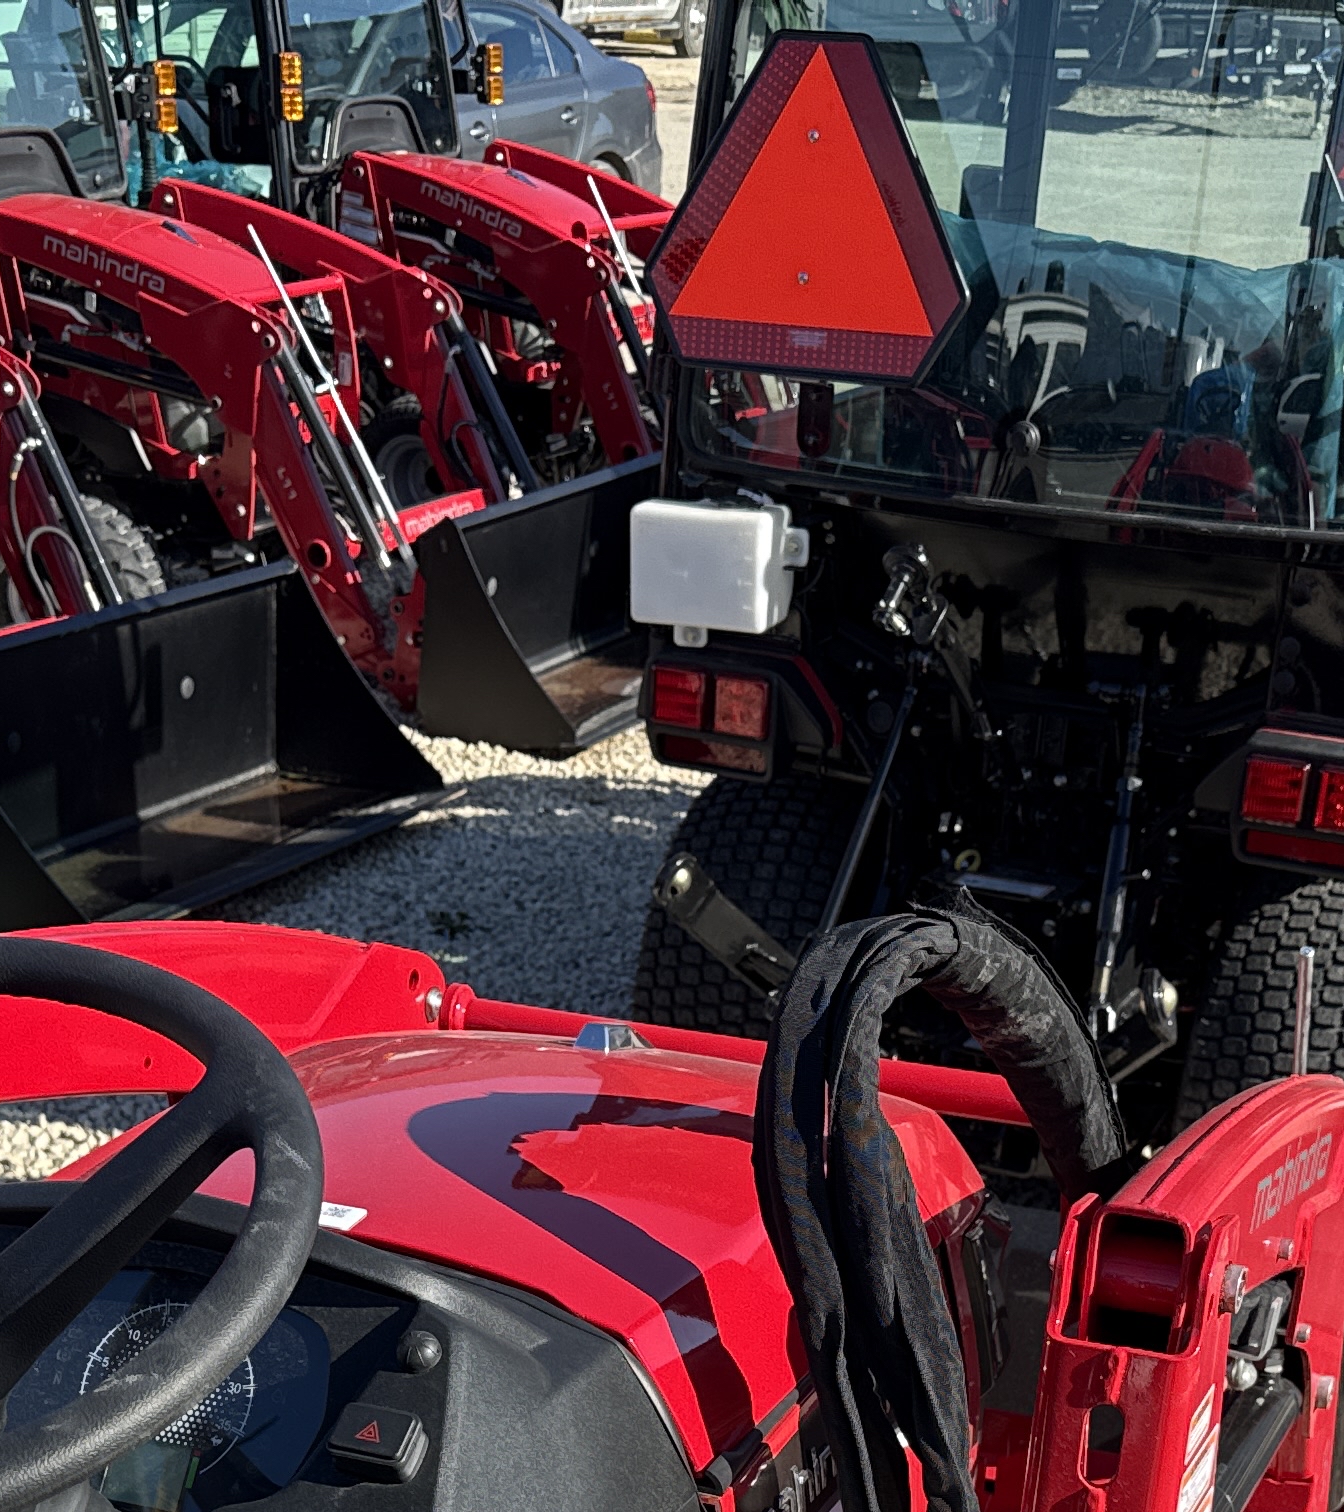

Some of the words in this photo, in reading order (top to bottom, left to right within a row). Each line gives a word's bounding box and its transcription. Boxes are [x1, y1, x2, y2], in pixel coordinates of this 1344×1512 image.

[420, 181, 523, 238] mahindra
[43, 234, 166, 295] mahindra
[1249, 1125, 1333, 1234] mahindra
[127, 1329, 142, 1342] 10
[101, 1356, 110, 1369] 5
[227, 1382, 242, 1395] 30
